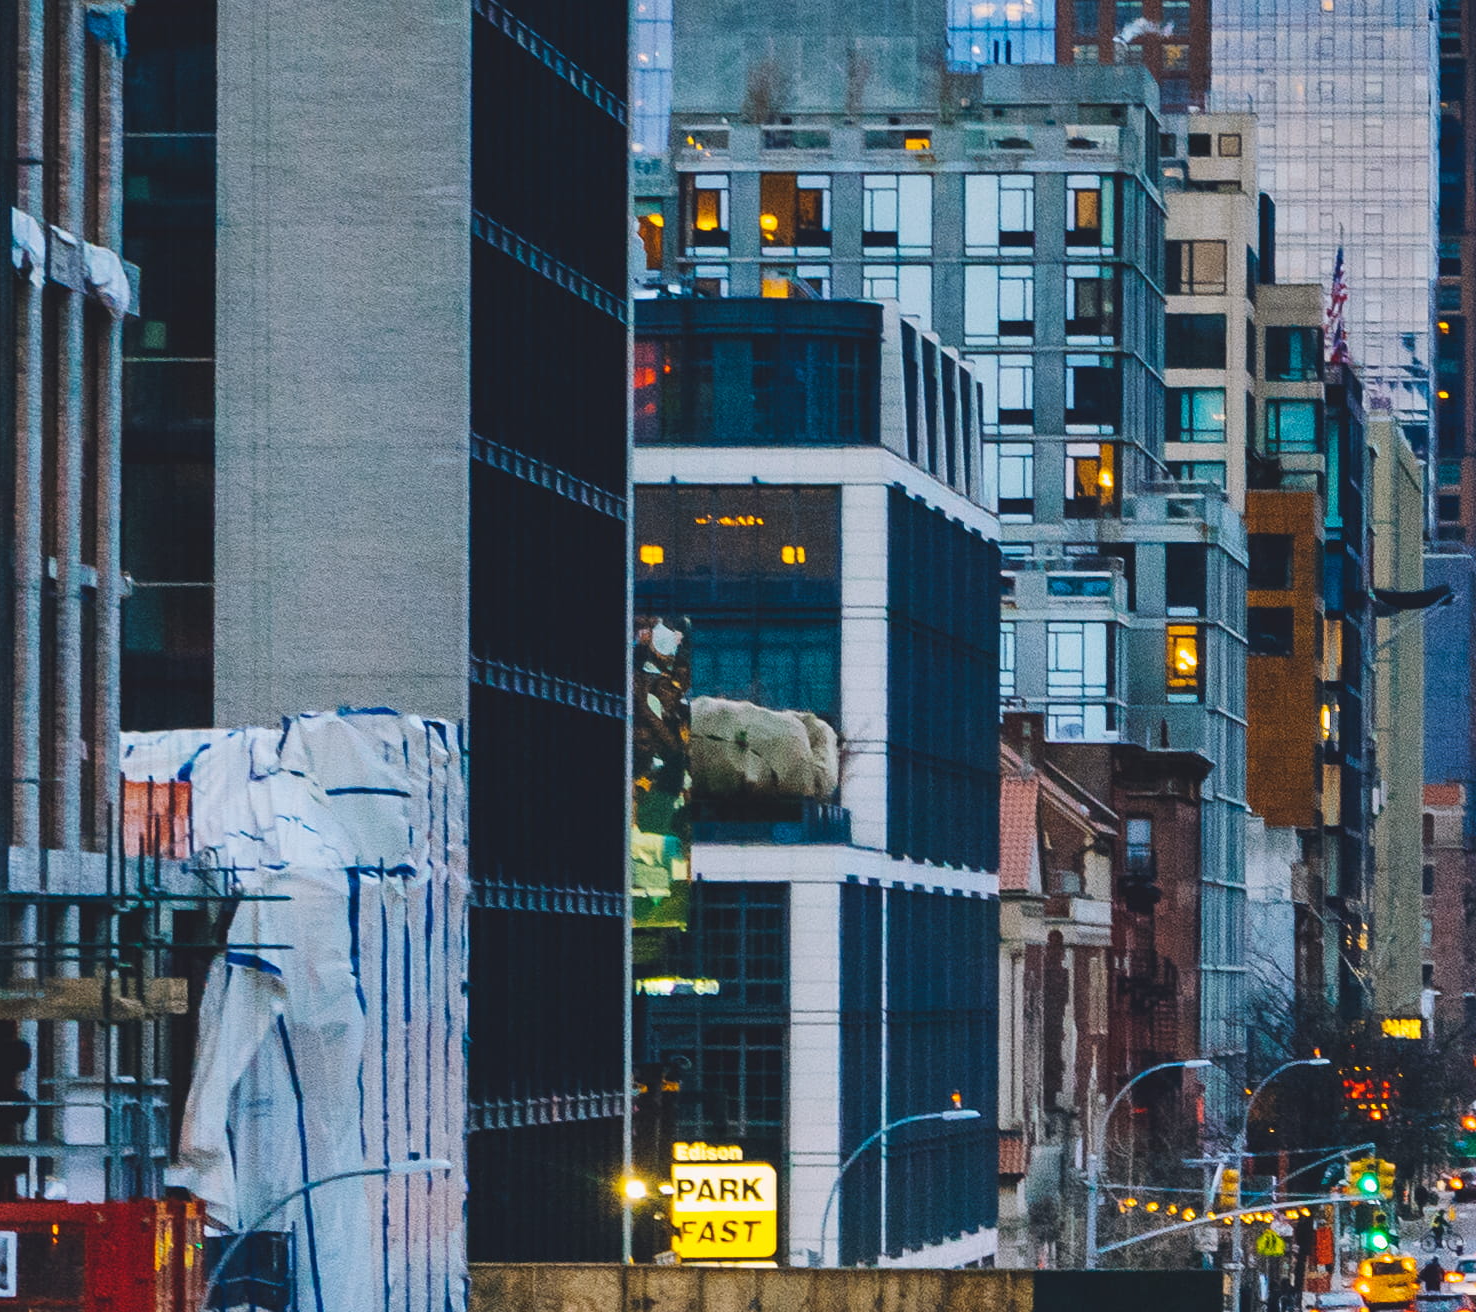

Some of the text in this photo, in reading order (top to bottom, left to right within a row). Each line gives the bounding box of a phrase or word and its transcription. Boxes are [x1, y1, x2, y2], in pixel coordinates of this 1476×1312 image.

[673, 1142, 744, 1162] Edison
[676, 1178, 764, 1202] PARK
[679, 1220, 763, 1244] FAST
